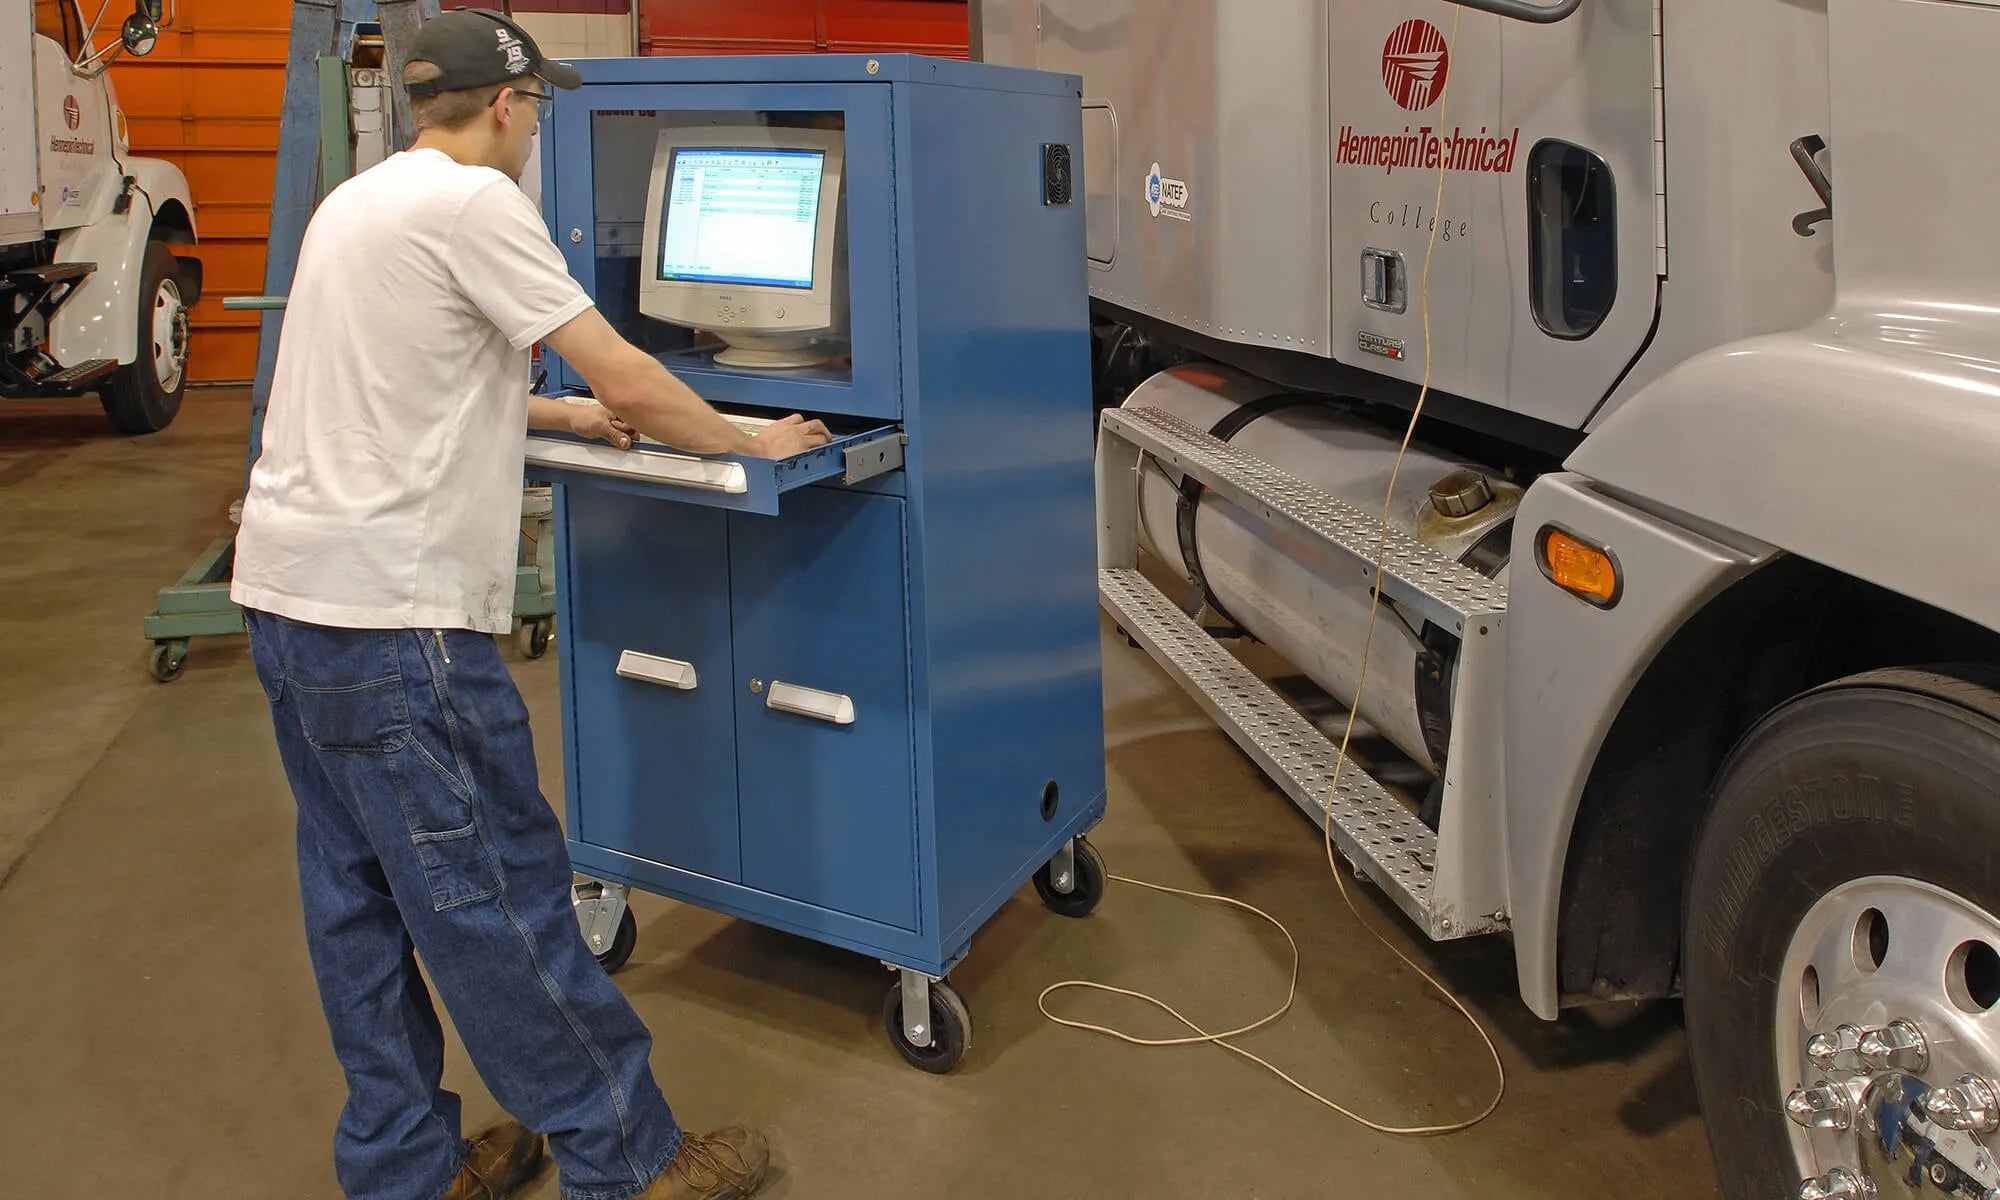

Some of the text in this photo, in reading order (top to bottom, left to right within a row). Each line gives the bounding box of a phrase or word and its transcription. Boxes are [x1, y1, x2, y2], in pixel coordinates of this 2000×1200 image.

[1162, 182, 1183, 200] NATEF
[1370, 201, 1467, 241] College
[1359, 332, 1402, 349] CENTURY
